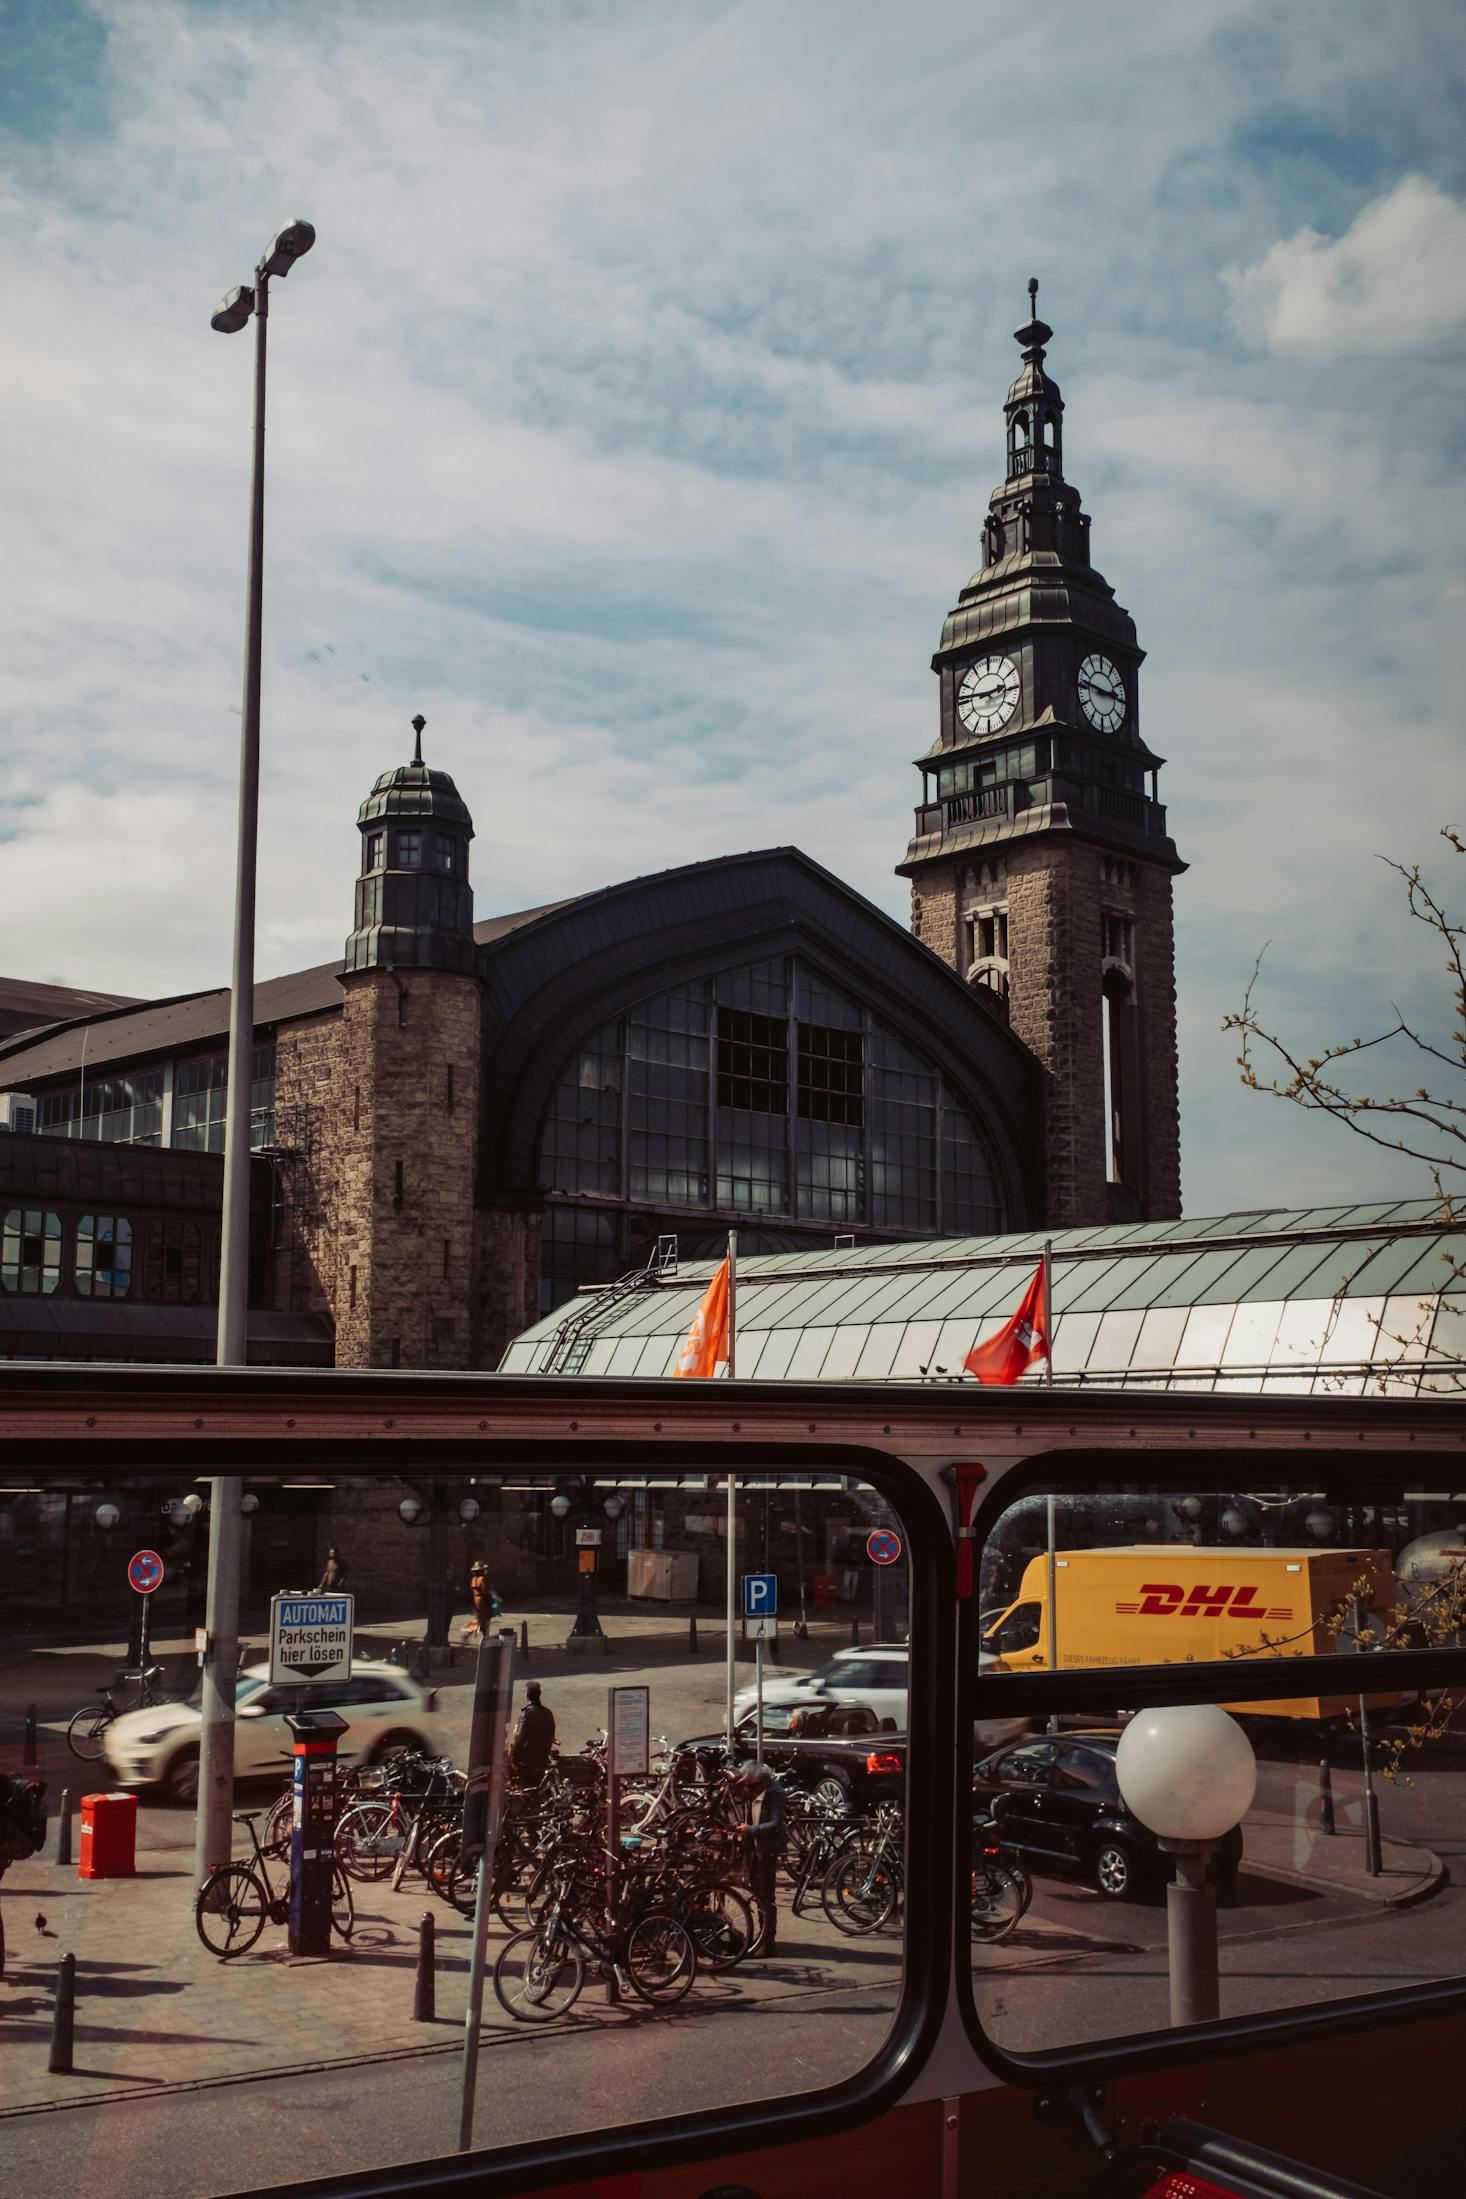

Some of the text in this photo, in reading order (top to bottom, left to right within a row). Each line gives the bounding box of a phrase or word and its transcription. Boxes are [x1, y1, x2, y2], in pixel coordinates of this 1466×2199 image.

[751, 1580, 768, 1610] P
[1138, 1584, 1268, 1619] DHL
[282, 1604, 345, 1624] AUTOMAT
[279, 1627, 346, 1645] Parkschein
[280, 1645, 344, 1663] hier lösen
[1086, 1655, 1119, 1665] FAHRZEUG
